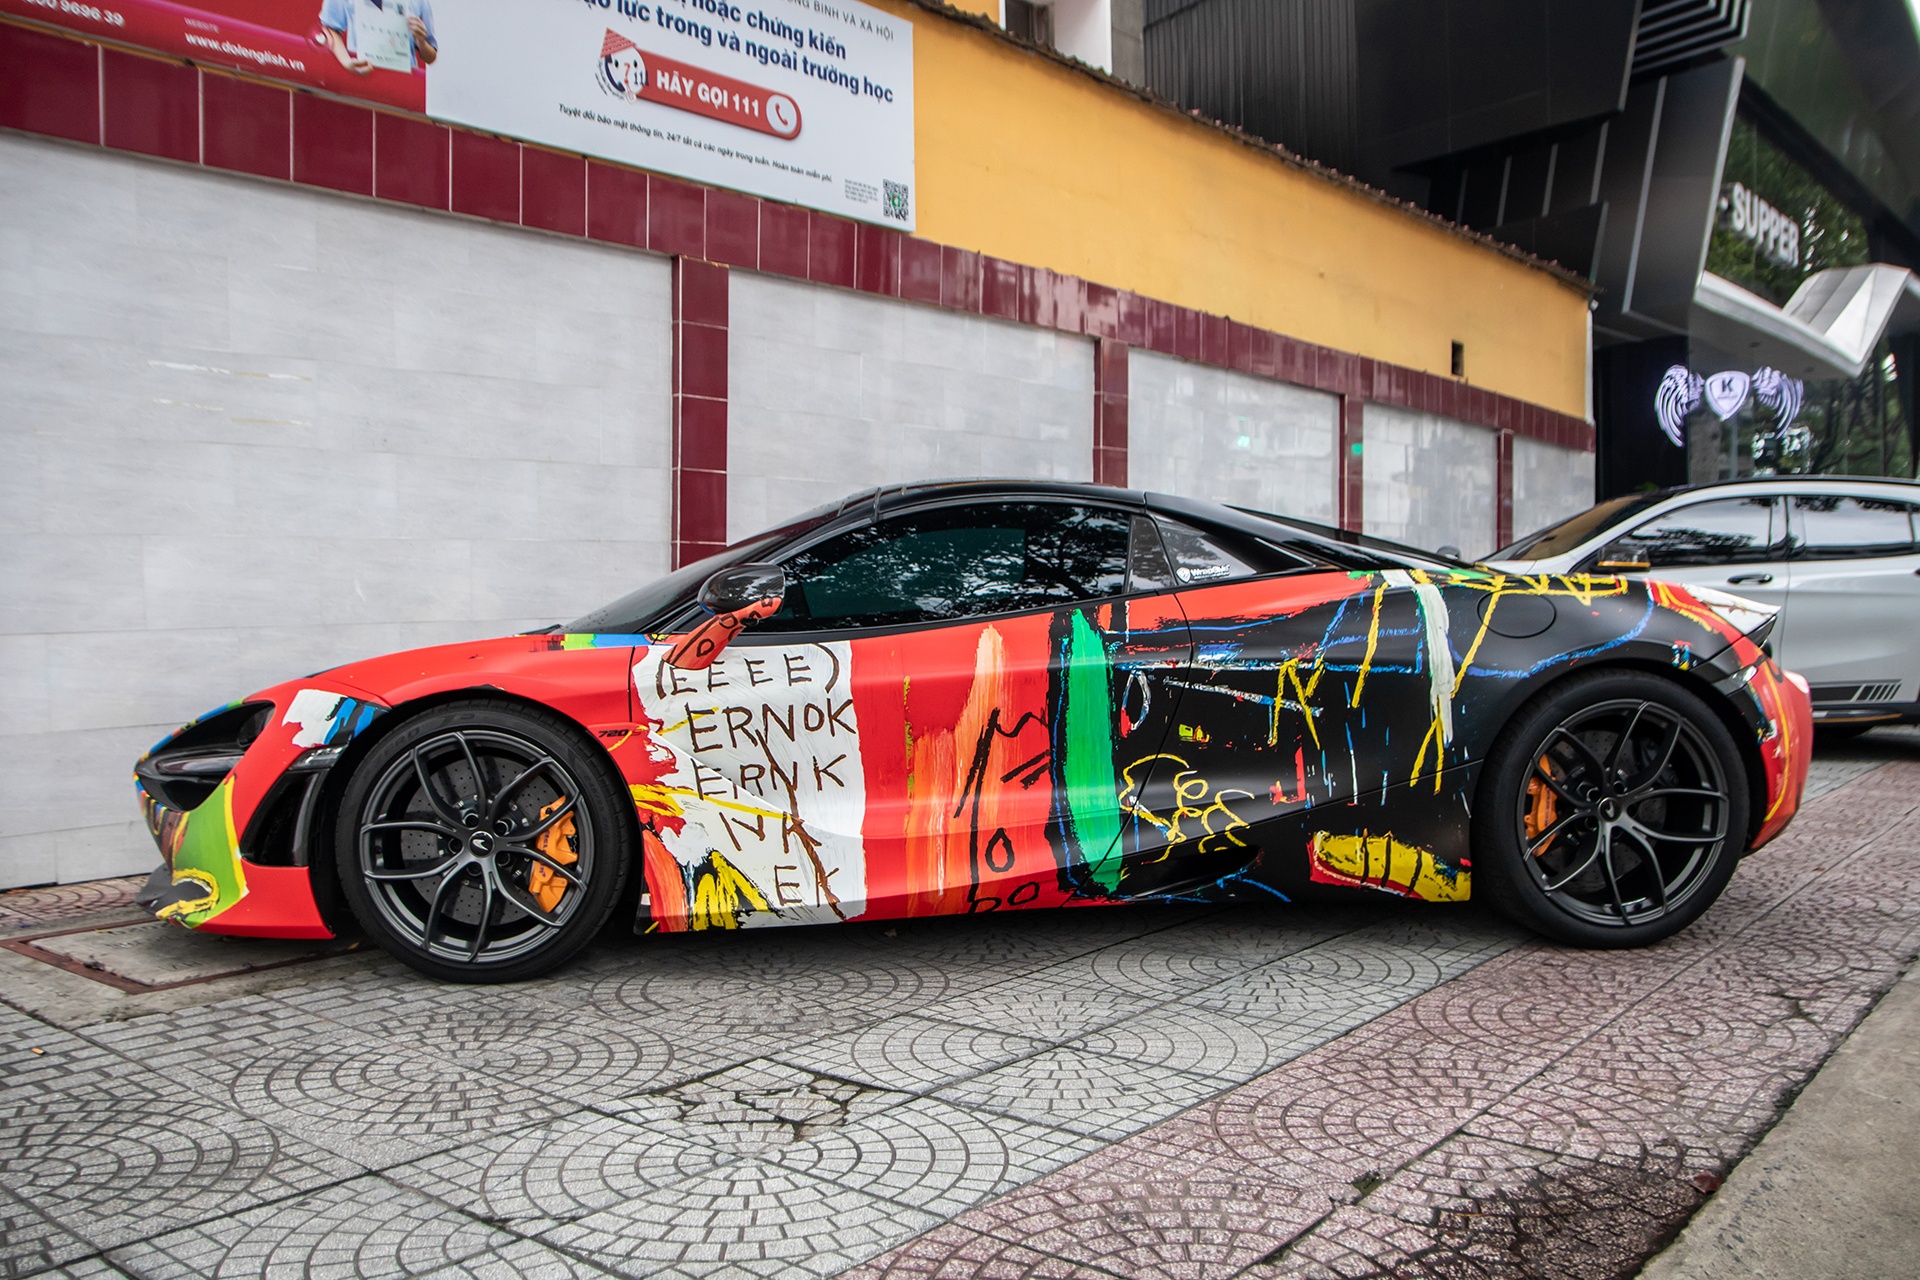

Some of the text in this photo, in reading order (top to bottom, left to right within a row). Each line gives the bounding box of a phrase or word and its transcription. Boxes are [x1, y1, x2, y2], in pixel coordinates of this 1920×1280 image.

[60, 0, 102, 22] 9696
[103, 10, 125, 28] 39
[746, 10, 804, 48] chứng
[808, 28, 847, 60] kiến
[814, 1, 840, 20] BINH
[876, 24, 894, 41] HỘI
[184, 32, 306, 71] www.dolenglish.vn
[656, 5, 712, 47] trong
[717, 30, 741, 53] và
[745, 39, 798, 71] ngoài
[802, 55, 859, 95] trường
[863, 75, 894, 104] học
[656, 70, 759, 118] HÃY GỌI 111
[1732, 181, 1800, 268] SUPPER
[1721, 376, 1735, 393] K
[685, 698, 856, 753] ERNOK
